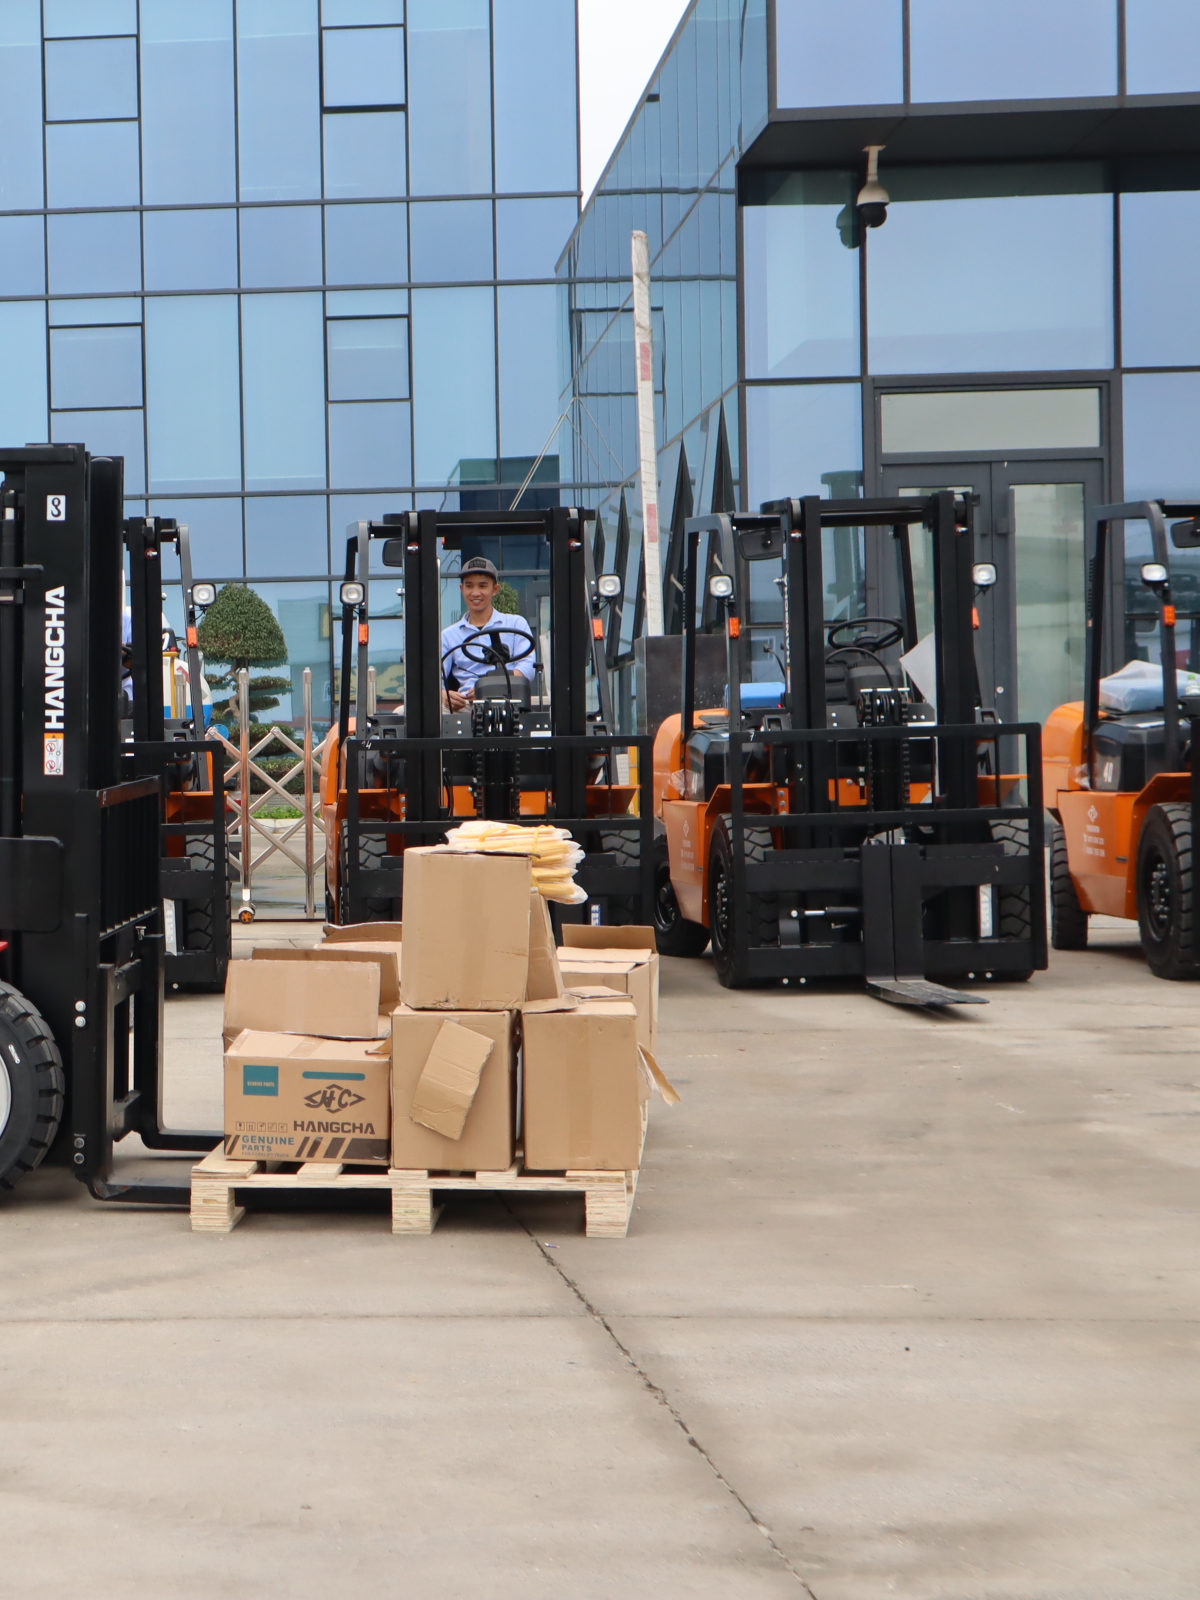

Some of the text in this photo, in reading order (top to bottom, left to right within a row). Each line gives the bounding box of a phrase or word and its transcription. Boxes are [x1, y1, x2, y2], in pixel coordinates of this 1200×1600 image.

[45, 585, 65, 730] HANGCHA
[293, 1120, 376, 1135] HANGCHA
[242, 1135, 295, 1146] GENUINE
[241, 1144, 273, 1152] PARTS
